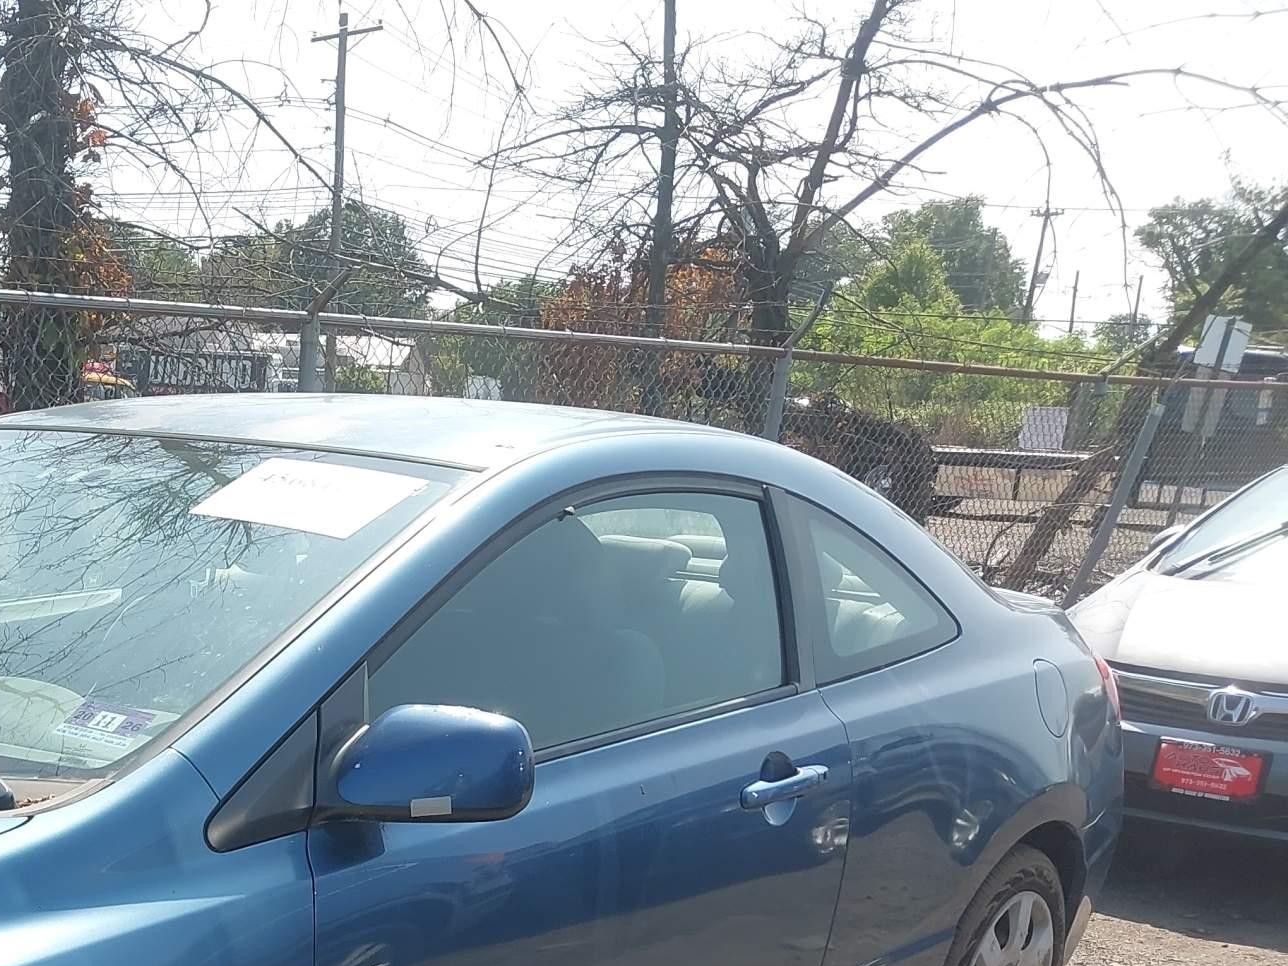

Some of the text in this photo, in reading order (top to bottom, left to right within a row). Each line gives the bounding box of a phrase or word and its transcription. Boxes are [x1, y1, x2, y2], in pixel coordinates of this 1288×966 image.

[73, 710, 143, 732] 20 11 26
